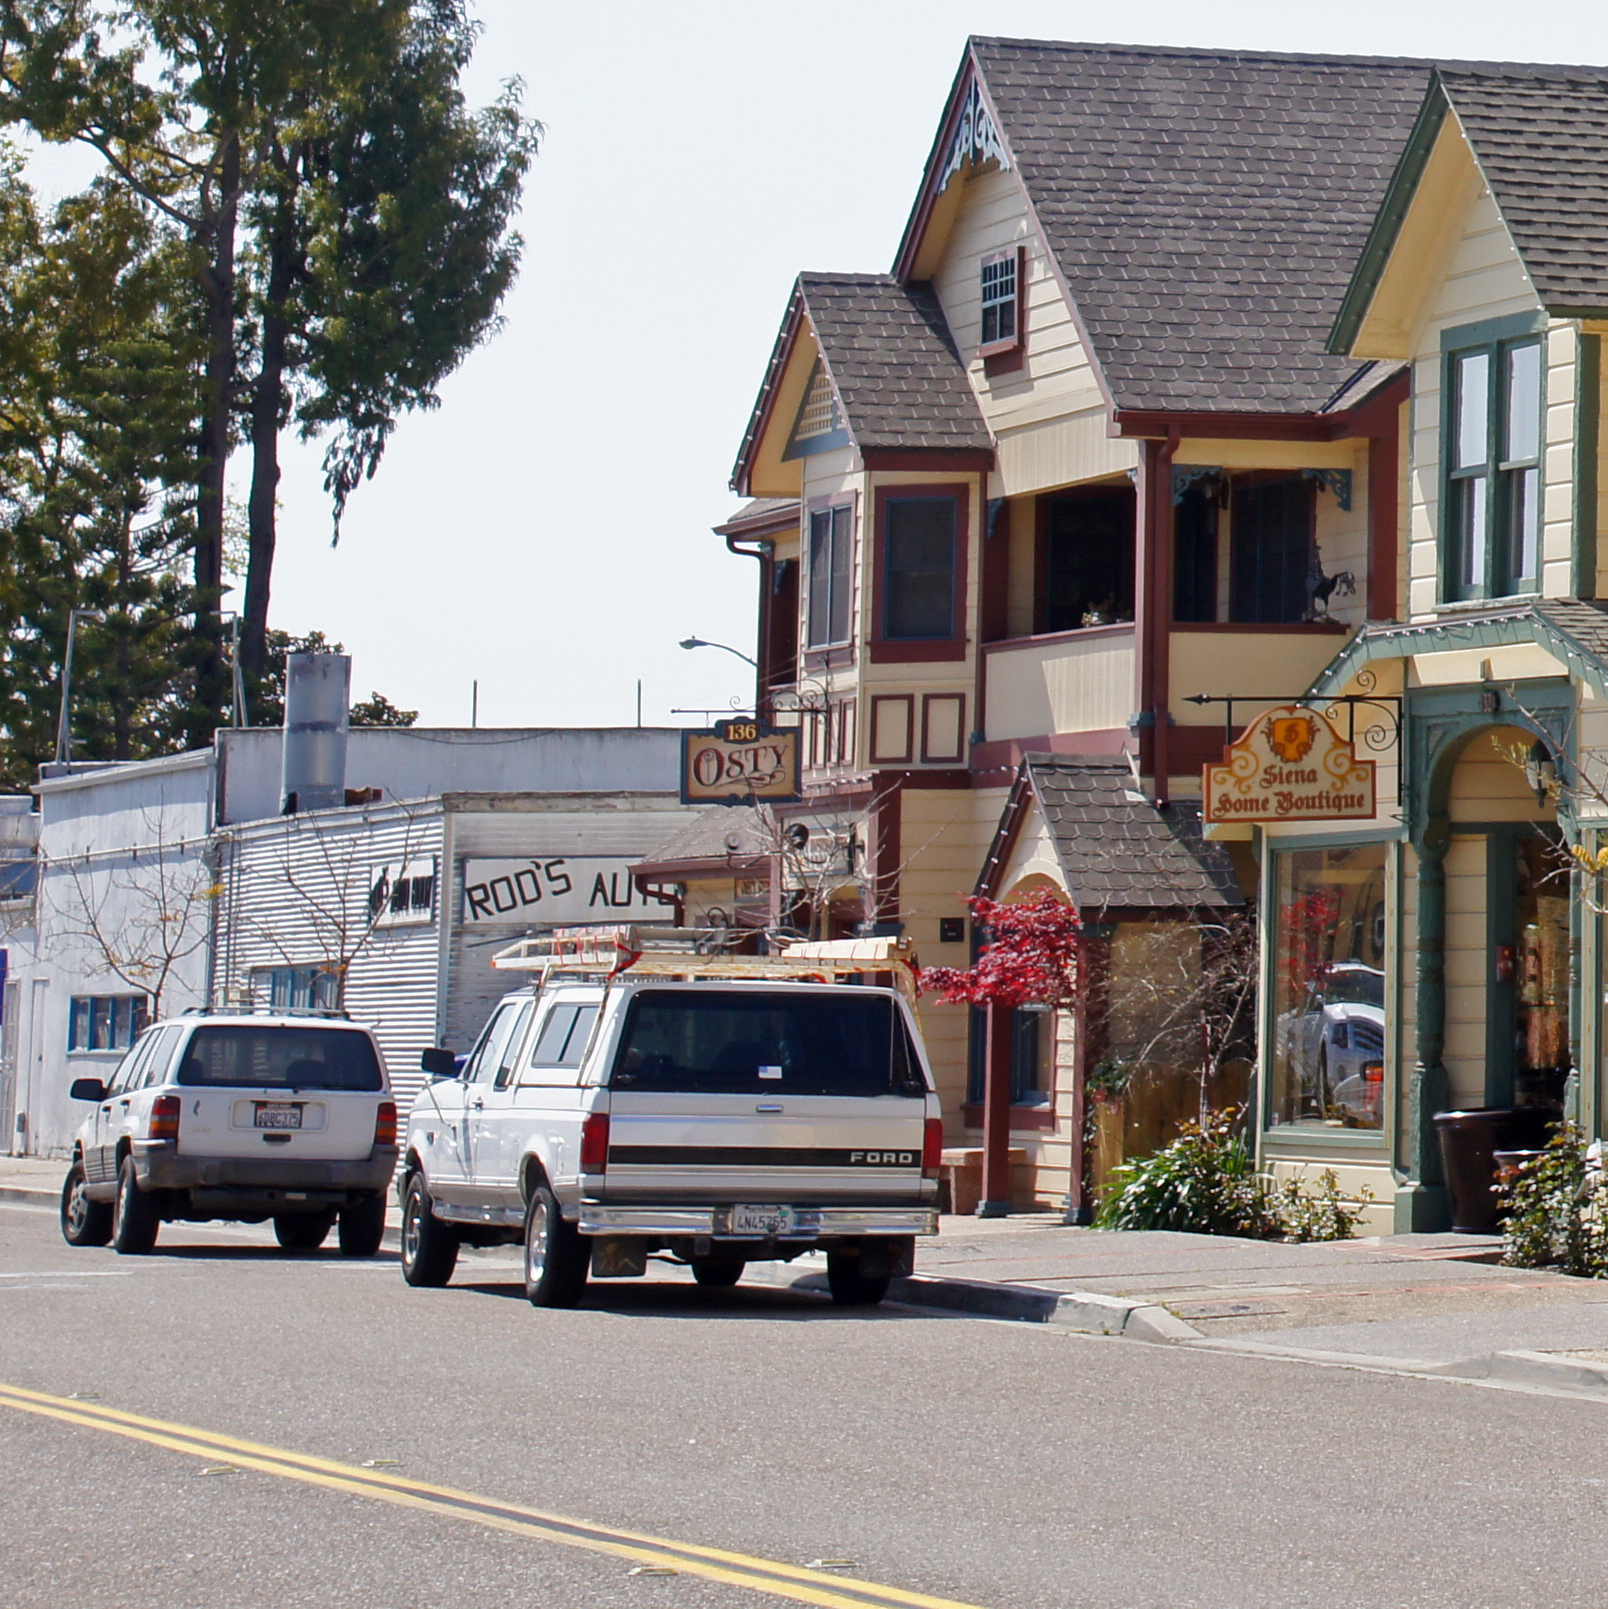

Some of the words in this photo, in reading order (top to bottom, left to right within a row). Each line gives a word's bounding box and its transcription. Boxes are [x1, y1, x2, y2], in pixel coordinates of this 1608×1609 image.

[727, 724, 757, 740] 136
[1259, 764, 1318, 789] Siena
[1212, 793, 1270, 818] Home
[1273, 790, 1366, 816] Boutique
[465, 859, 573, 920] ROD'S
[850, 1152, 913, 1163] FORD
